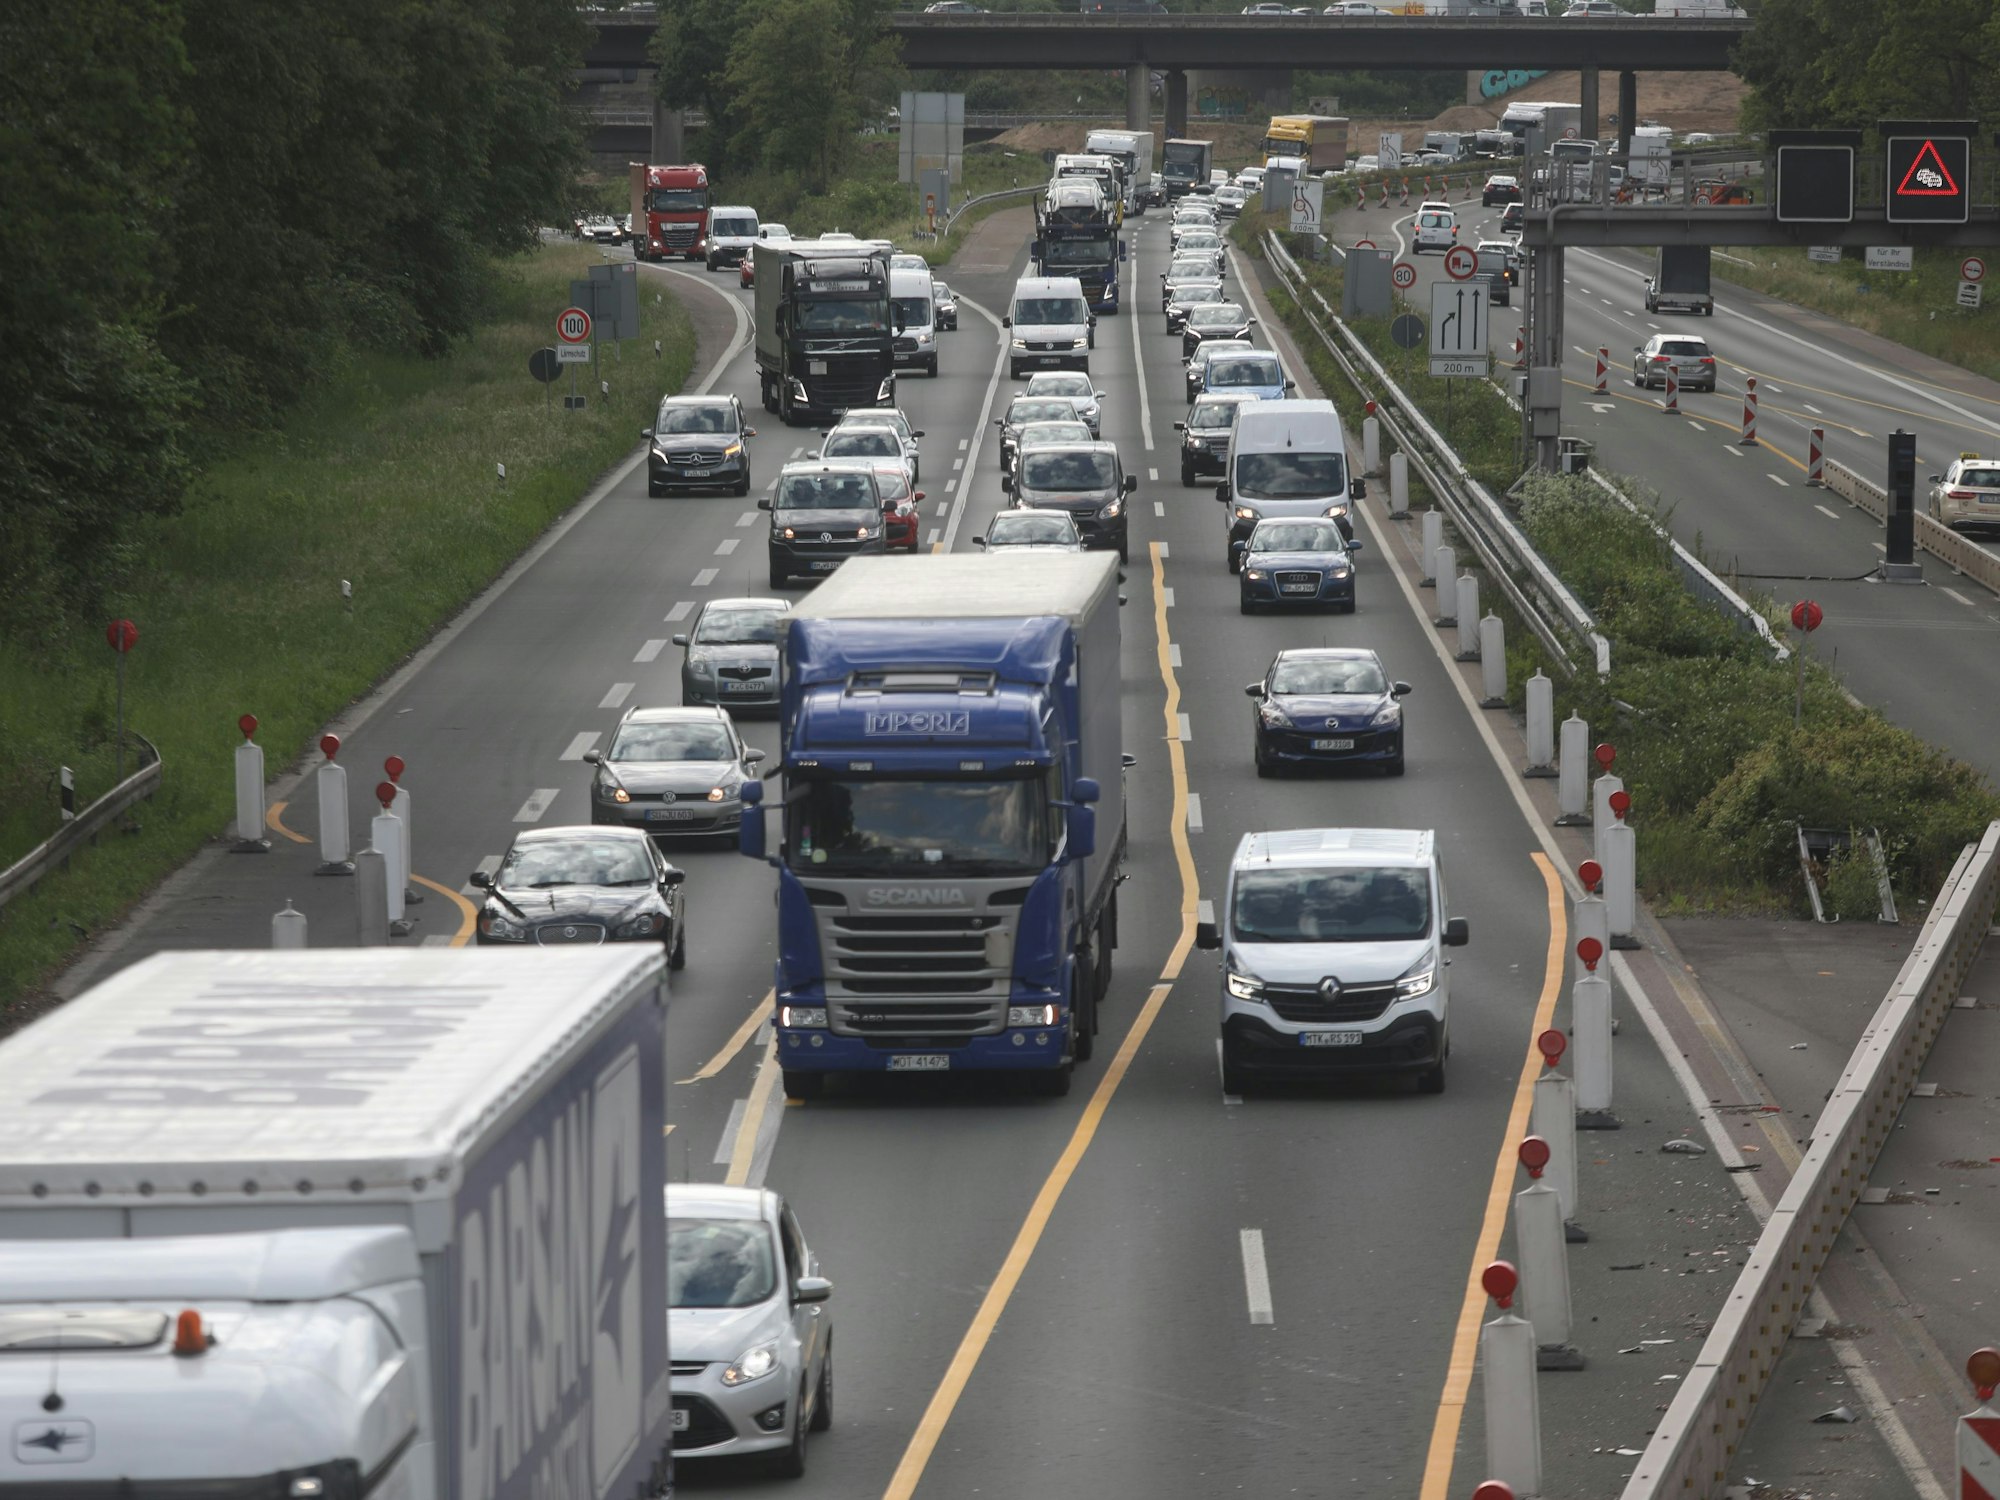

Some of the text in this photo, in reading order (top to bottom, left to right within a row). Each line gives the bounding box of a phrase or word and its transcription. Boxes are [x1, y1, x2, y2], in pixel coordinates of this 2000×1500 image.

[1868, 259, 1910, 268] Verständnis
[1396, 271, 1411, 282] 80
[564, 318, 584, 333] 100
[560, 349, 586, 359] Lärmschutz
[1444, 363, 1462, 373] 200
[866, 887, 967, 906] SCANIA
[893, 1056, 948, 1068] WOT 41475
